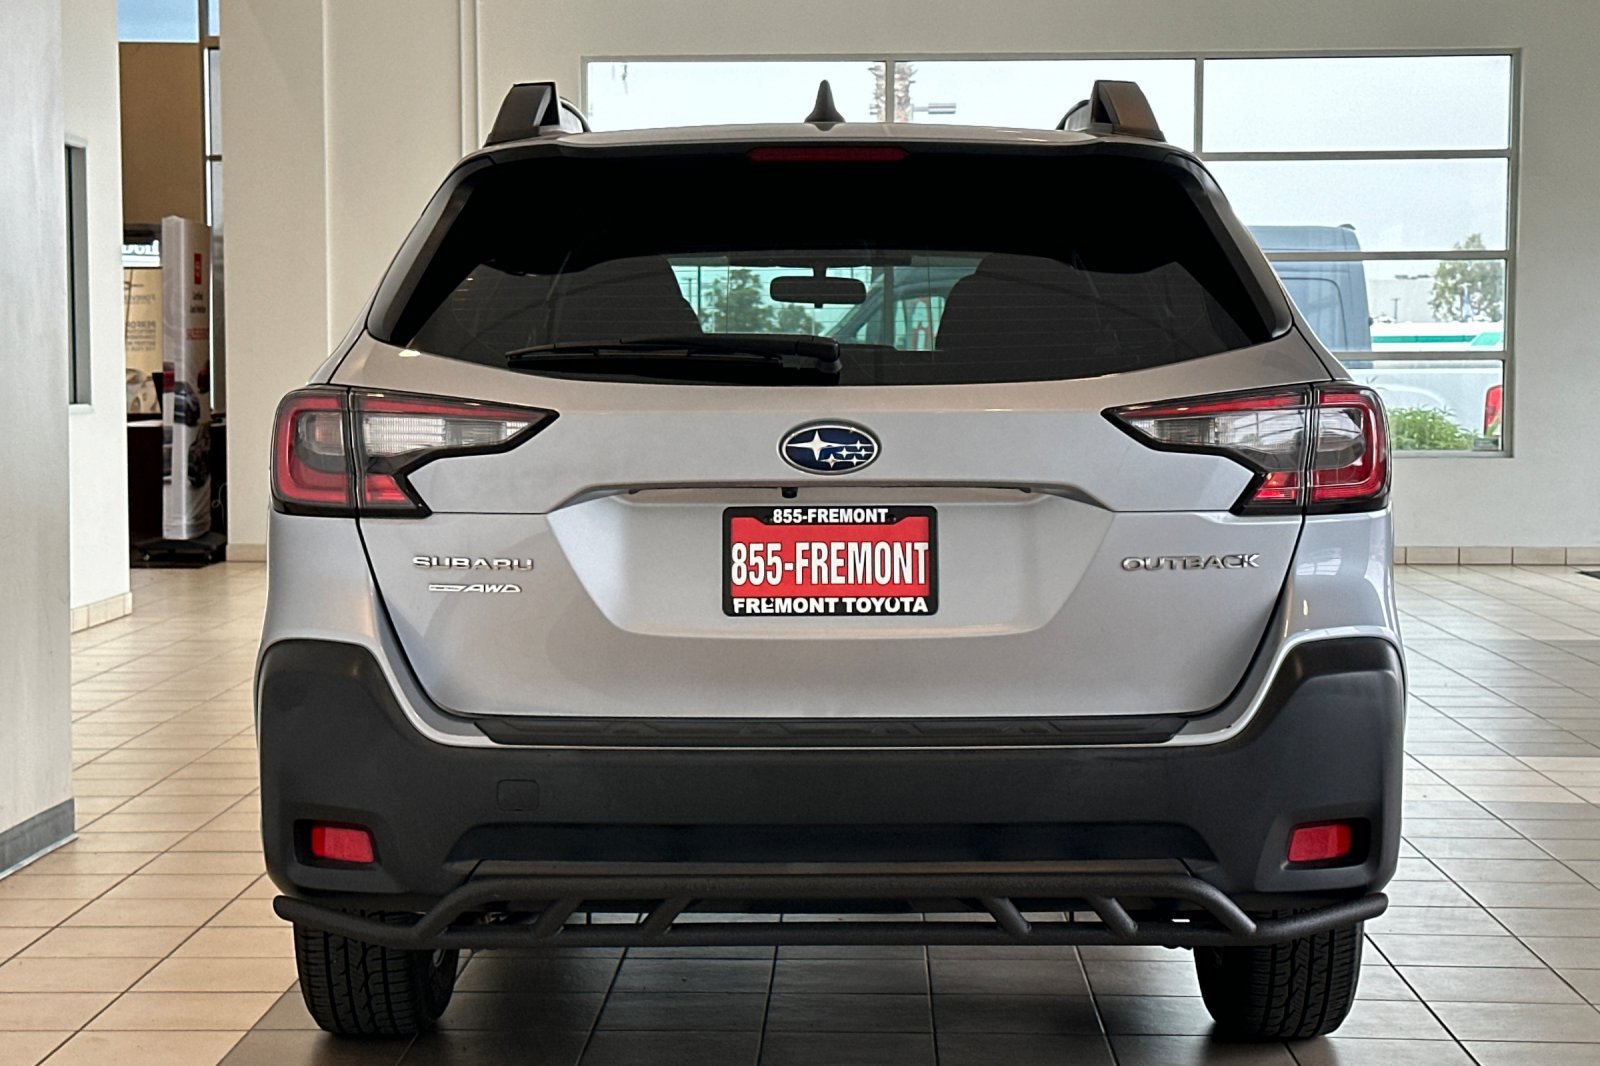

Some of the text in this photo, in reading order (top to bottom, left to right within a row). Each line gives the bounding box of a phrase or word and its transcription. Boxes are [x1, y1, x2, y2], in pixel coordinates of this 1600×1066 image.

[772, 508, 888, 524] 855-FREMONT
[412, 555, 533, 571] SUBARU
[731, 541, 929, 586] 855-FREMONT
[1121, 553, 1260, 571] OUTBACK
[463, 584, 522, 593] AWD
[733, 596, 929, 614] FREMONT TOYOTA
